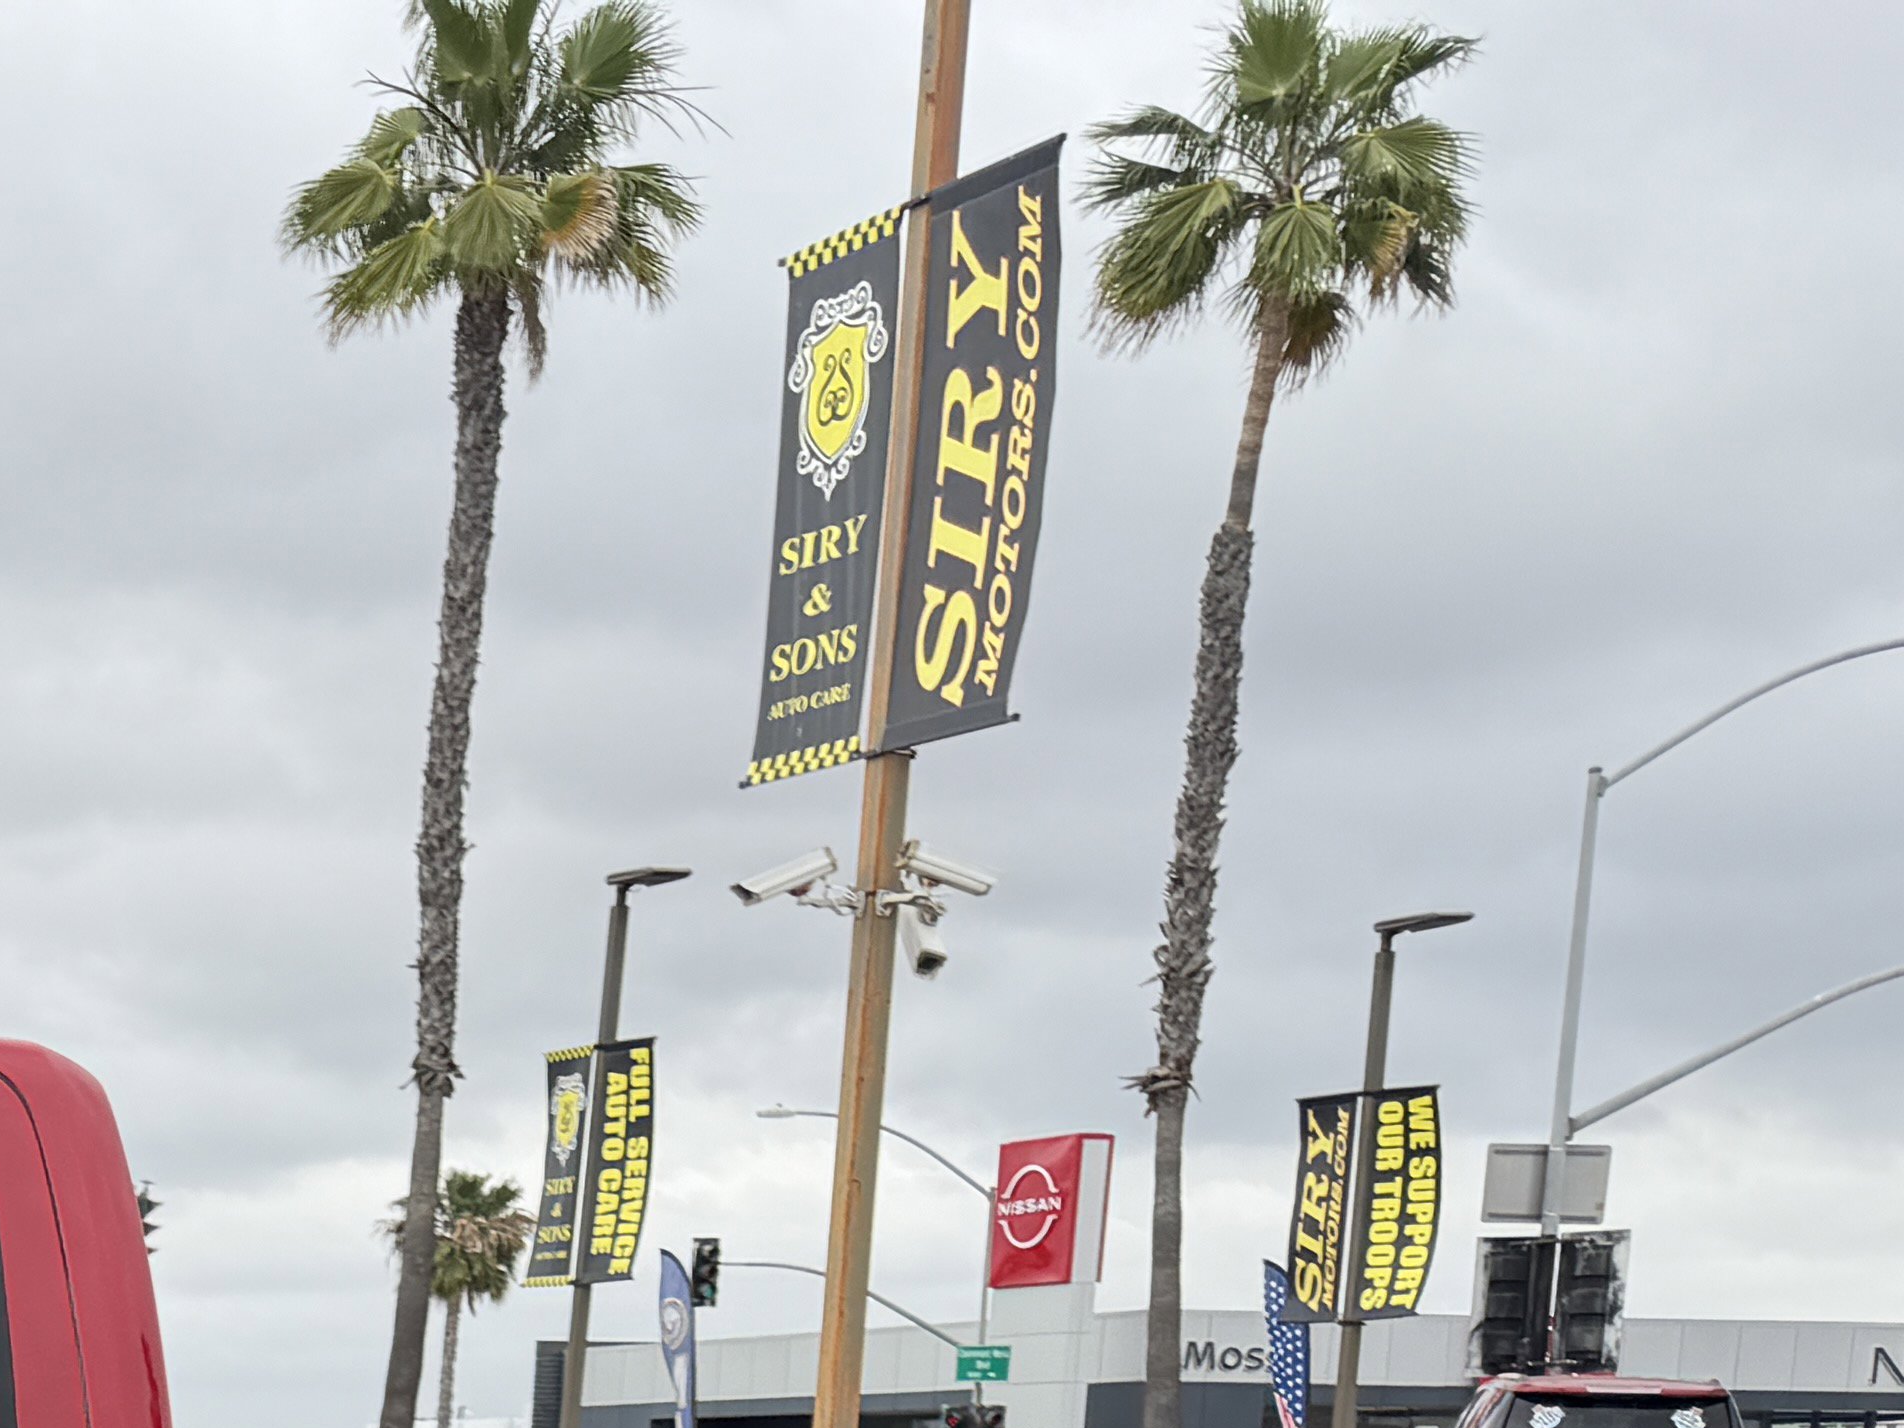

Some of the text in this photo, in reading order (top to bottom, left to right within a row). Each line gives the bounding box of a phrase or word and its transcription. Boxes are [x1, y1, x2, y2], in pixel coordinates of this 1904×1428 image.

[915, 209, 1009, 708] SIRY
[972, 185, 1043, 697] MOTORS.COM
[779, 514, 867, 575] SIRY
[803, 583, 832, 617] &
[767, 683, 851, 720] AUTO CARE
[769, 624, 858, 682] SONS
[590, 1071, 628, 1256] AUTO CARE
[607, 1047, 650, 1276] FULL SERVICE
[997, 1196, 1062, 1216] NISSAN
[1294, 1108, 1335, 1313] SIRY
[1359, 1100, 1405, 1312] OUR TROOPS
[1389, 1095, 1437, 1310] WE SUPPORT
